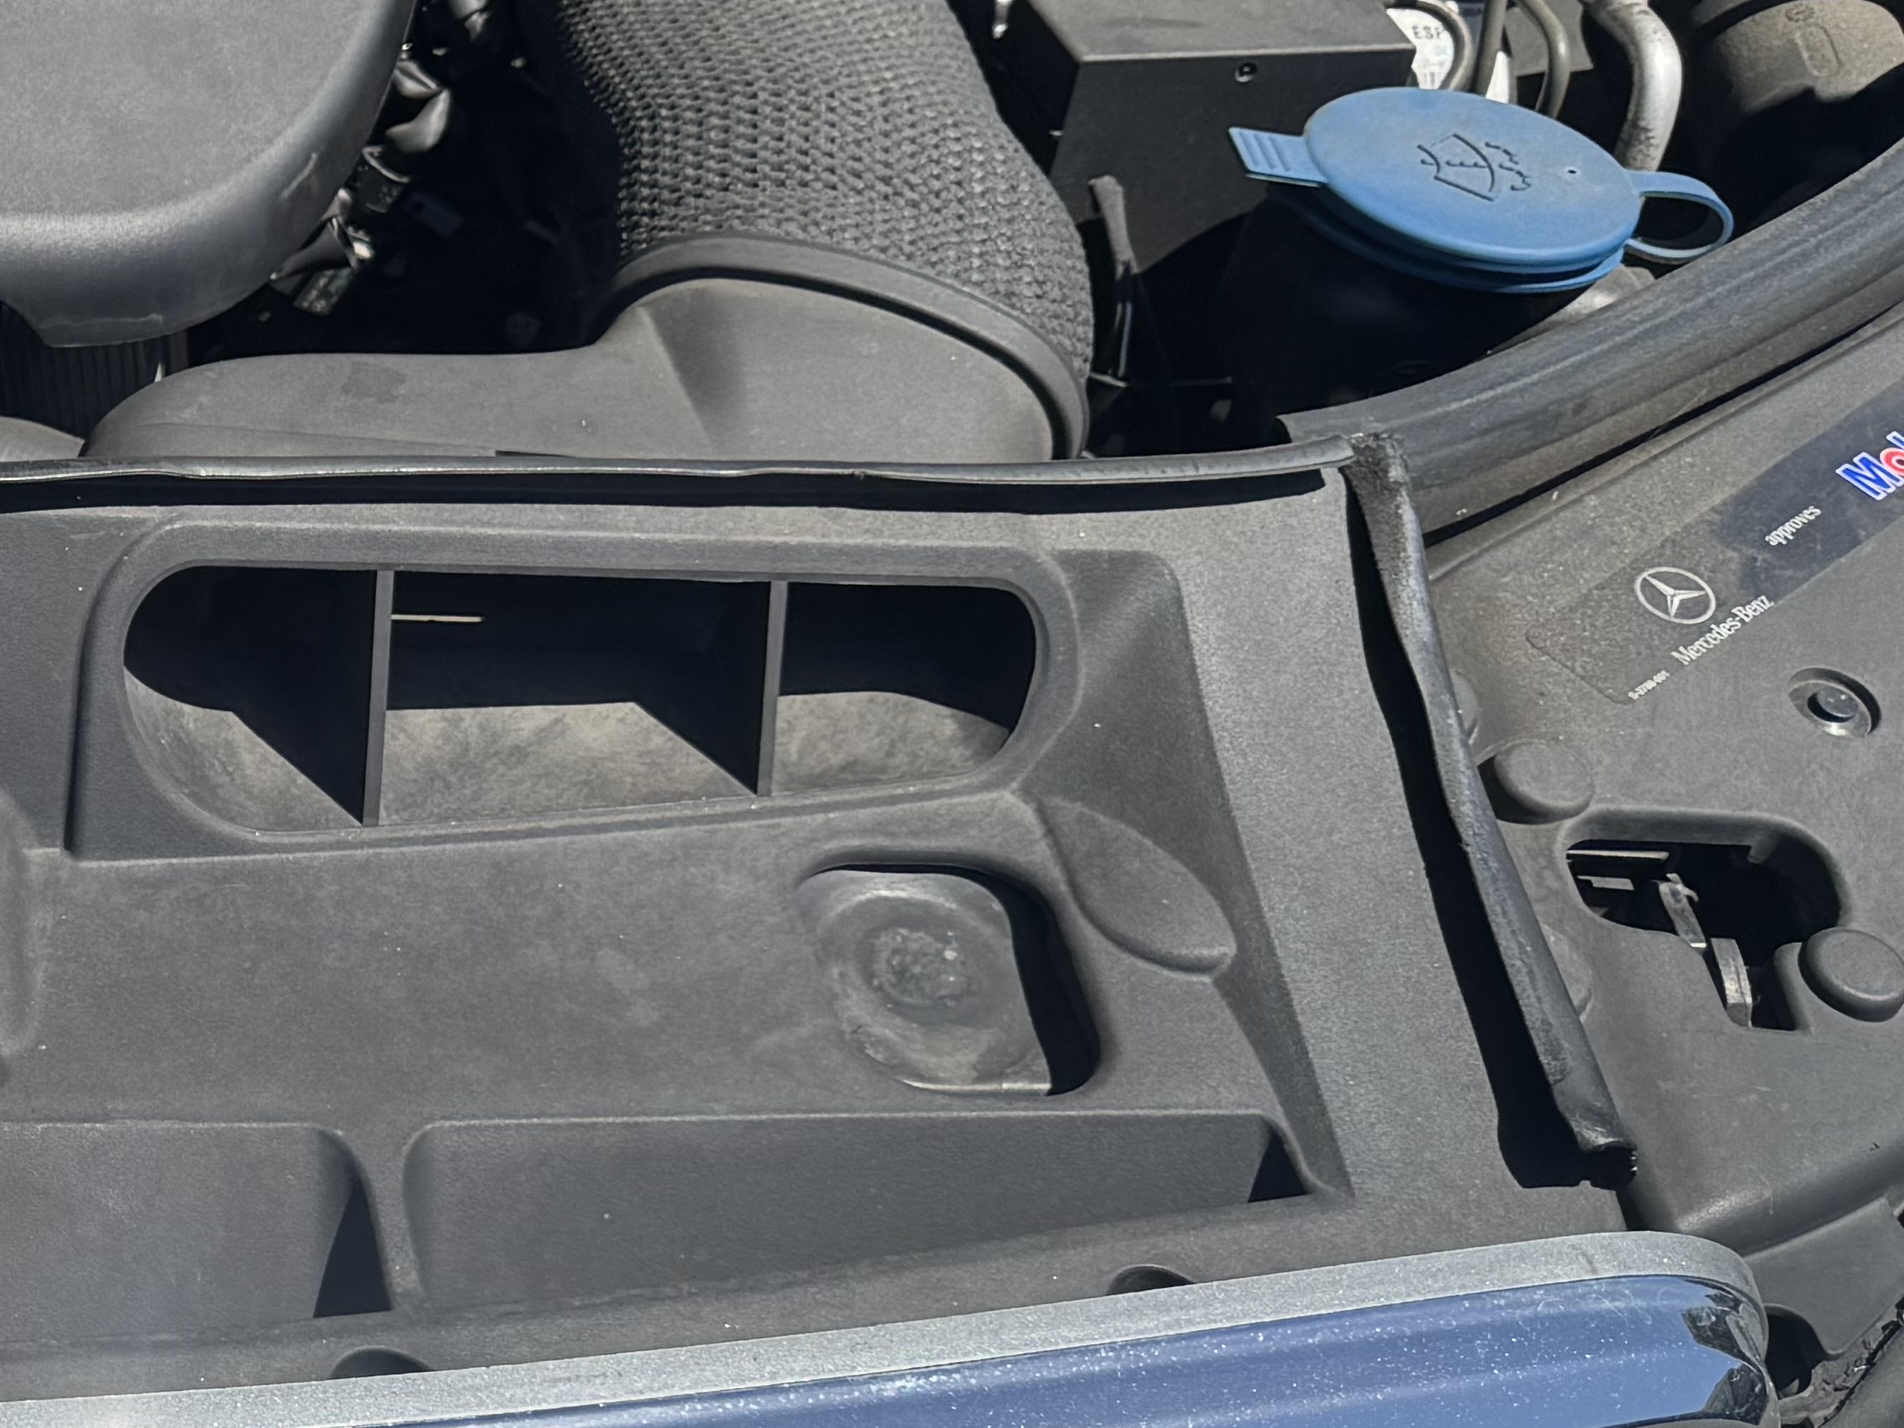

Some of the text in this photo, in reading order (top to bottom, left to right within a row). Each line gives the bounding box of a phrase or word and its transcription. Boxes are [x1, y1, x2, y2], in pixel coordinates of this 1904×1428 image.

[1835, 430, 1904, 501] Mo
[1764, 505, 1822, 548] approves
[1671, 594, 1775, 666] Mercedes-Benz
